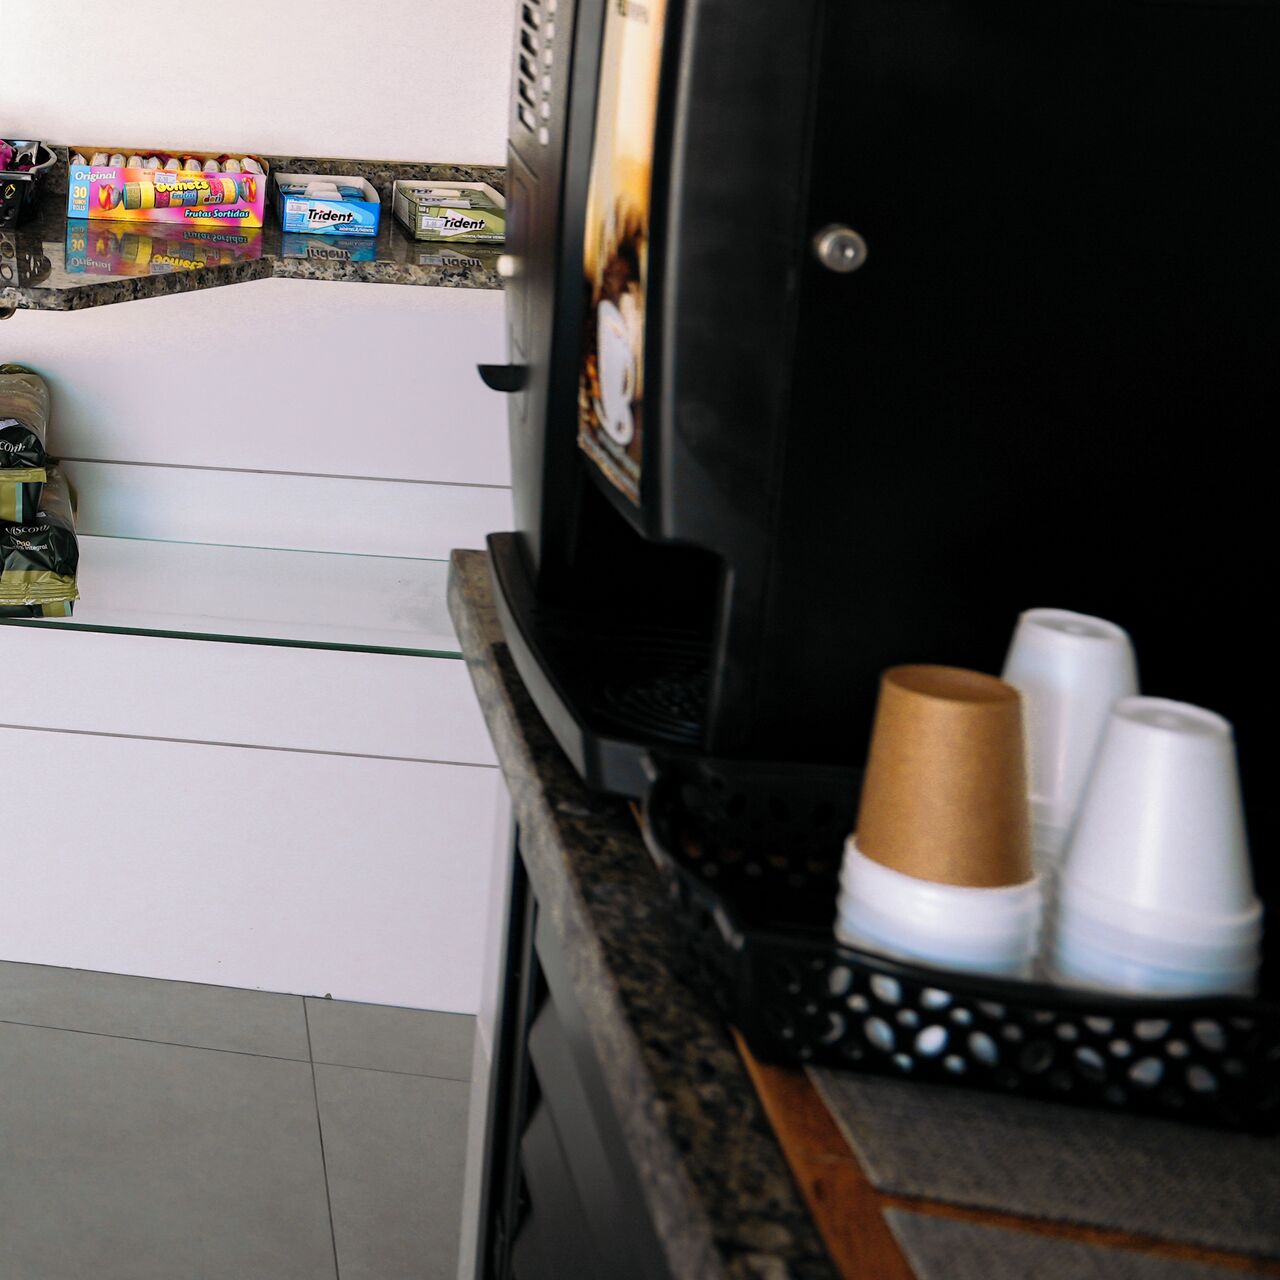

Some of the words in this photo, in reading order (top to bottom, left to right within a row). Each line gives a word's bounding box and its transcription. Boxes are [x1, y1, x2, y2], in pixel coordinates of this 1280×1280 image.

[75, 171, 116, 182] Original
[73, 186, 87, 198] 30
[184, 209, 212, 218] Frutas
[213, 209, 249, 218] Sortidas
[308, 209, 353, 223] Trident
[438, 217, 485, 231] Trident
